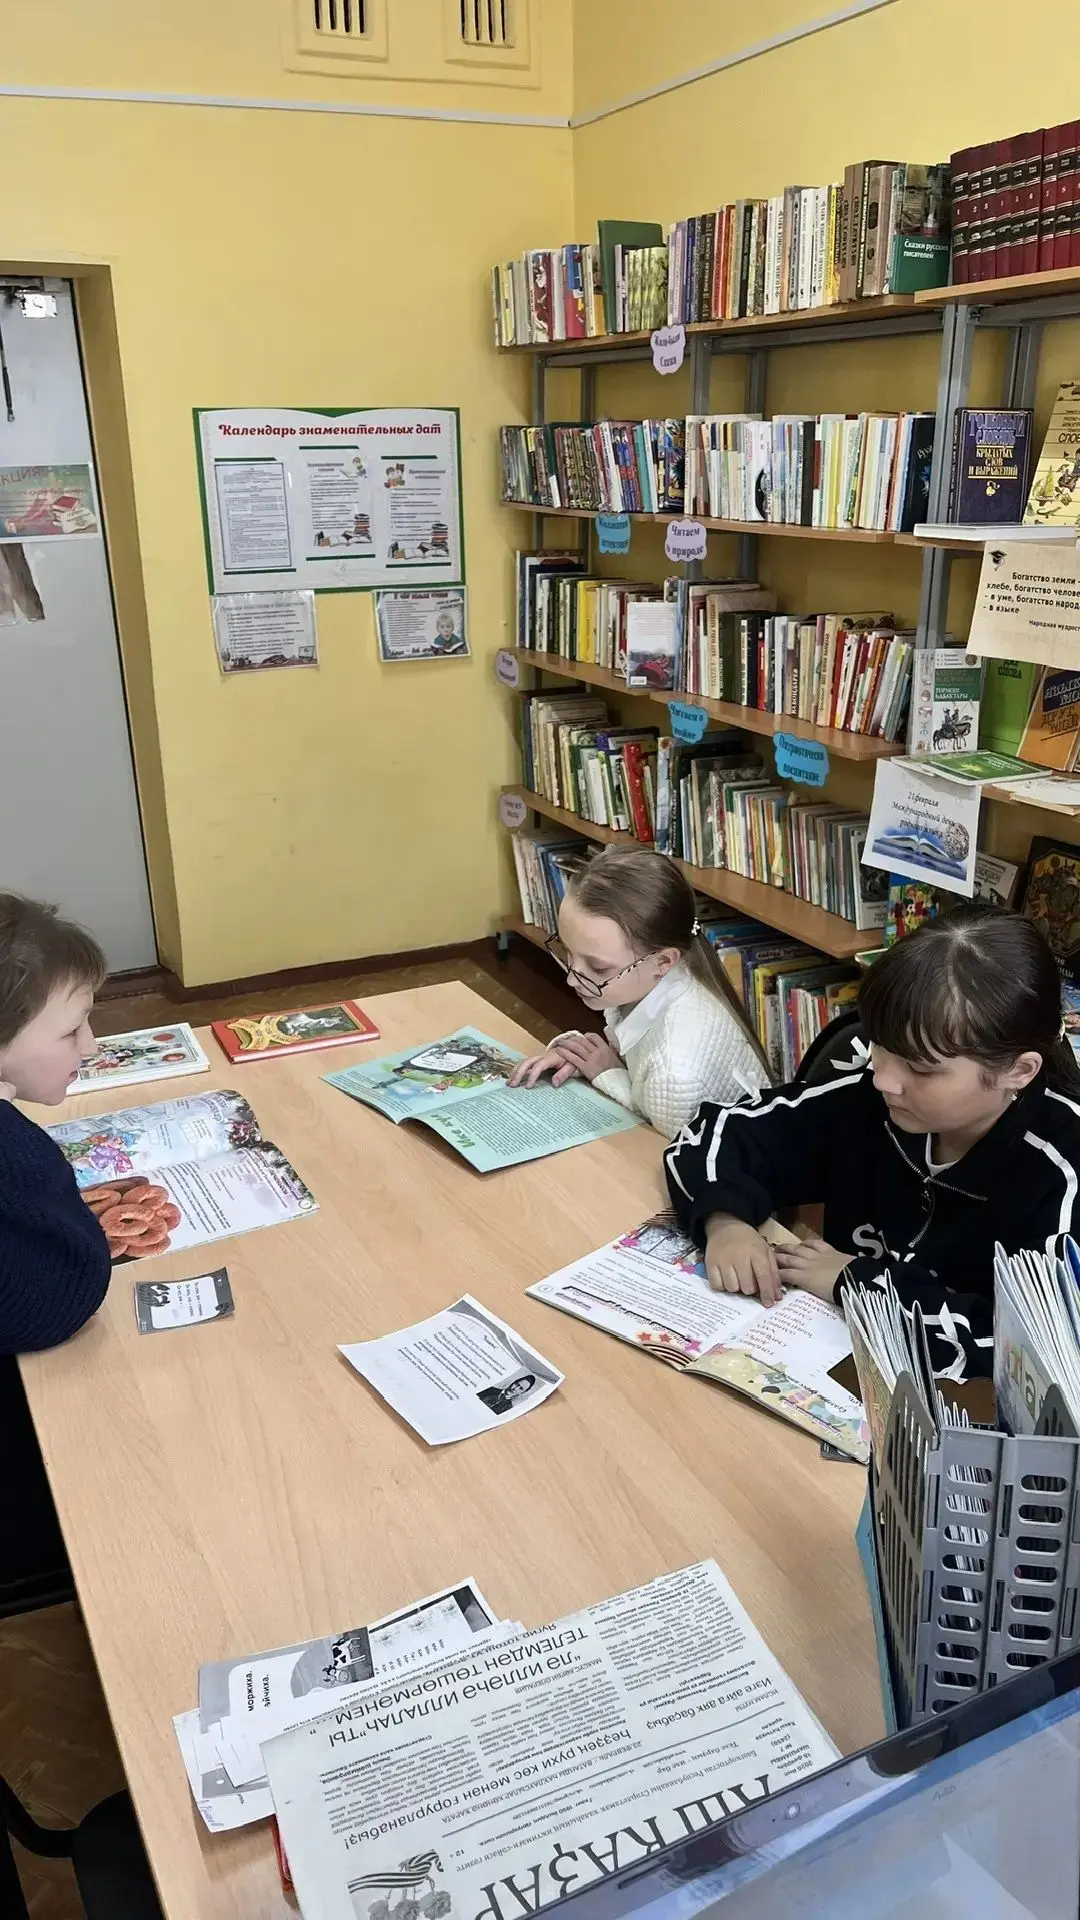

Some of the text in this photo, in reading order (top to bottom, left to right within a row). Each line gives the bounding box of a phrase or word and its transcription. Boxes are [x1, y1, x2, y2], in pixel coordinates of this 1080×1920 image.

[904, 238, 925, 251] Сказки
[903, 250, 934, 260] писателей
[218, 423, 441, 438] Календарь знаменательных дат
[1012, 572, 1076, 584] Богатство земли
[986, 582, 1012, 592] хлебе,
[1014, 584, 1052, 595] богатство
[996, 605, 1020, 614] языке
[997, 594, 1015, 603] уме,
[1016, 595, 1054, 606] богатство
[1055, 601, 1080, 611] народ
[483, 1623, 587, 1673] ТЕЛЕМДӘН
[513, 1675, 551, 1694] ОПЕРАЦИЯ
[743, 1676, 772, 1694] Изге
[539, 1746, 575, 1769] рухи
[512, 1763, 538, 1781] көс
[461, 1774, 511, 1801] менән
